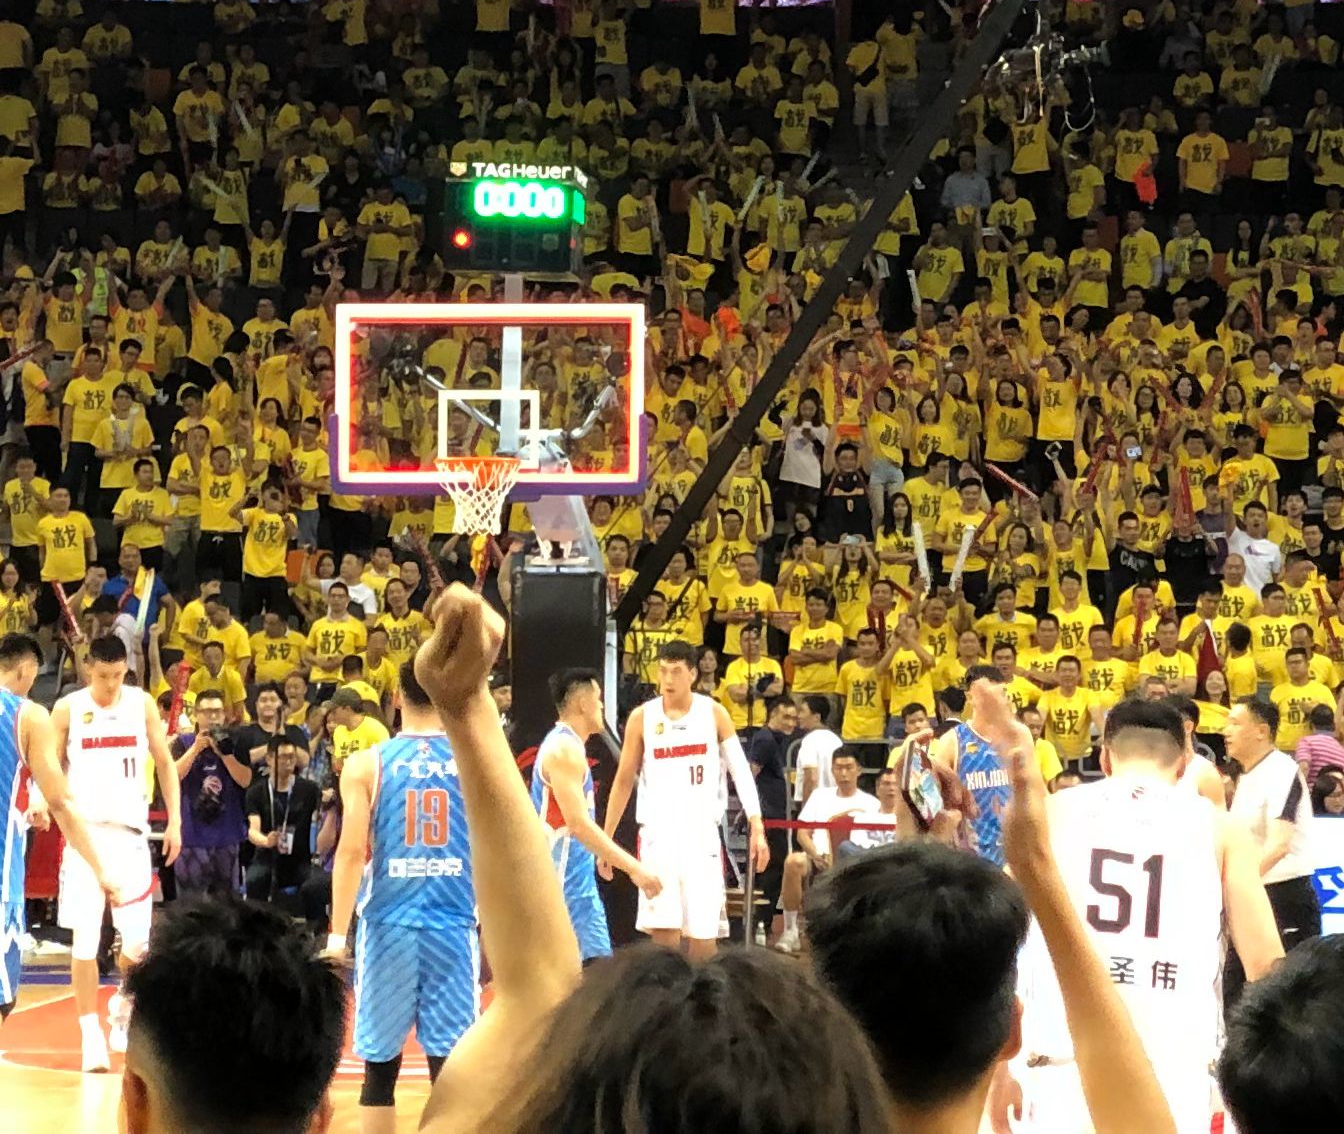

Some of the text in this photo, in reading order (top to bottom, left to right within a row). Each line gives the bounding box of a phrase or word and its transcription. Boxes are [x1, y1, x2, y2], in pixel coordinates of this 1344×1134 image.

[123, 757, 137, 779] 11
[688, 764, 705, 786] 18
[404, 788, 450, 847] 13
[1086, 848, 1165, 939] 51
